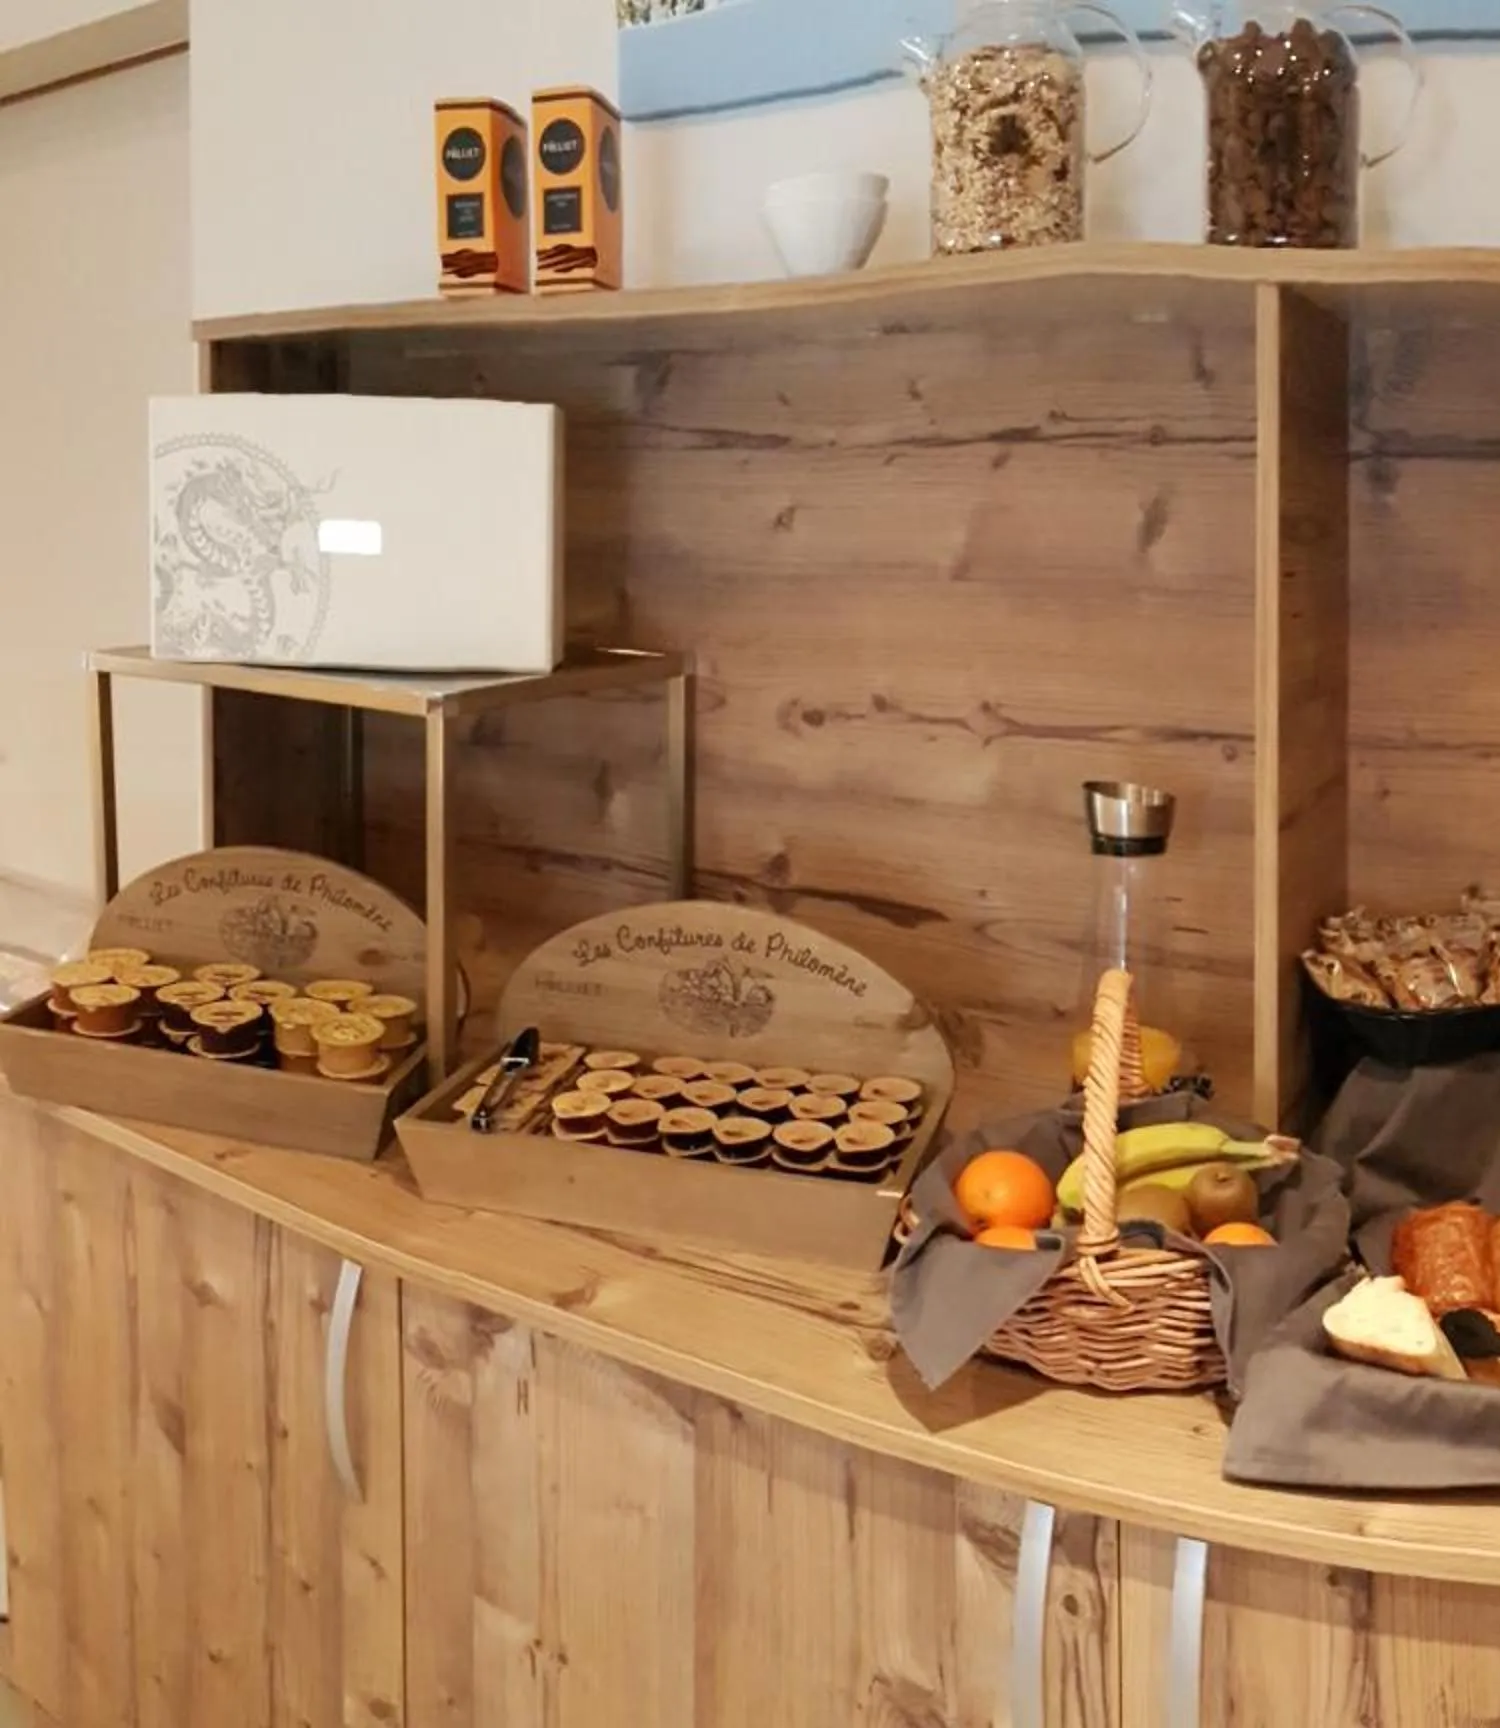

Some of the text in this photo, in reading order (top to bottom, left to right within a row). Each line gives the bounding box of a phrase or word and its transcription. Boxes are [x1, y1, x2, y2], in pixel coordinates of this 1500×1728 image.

[149, 880, 181, 907] Les
[183, 867, 274, 895] Confitures
[280, 870, 302, 892] de
[571, 924, 868, 997] Les Confitures de Philomène
